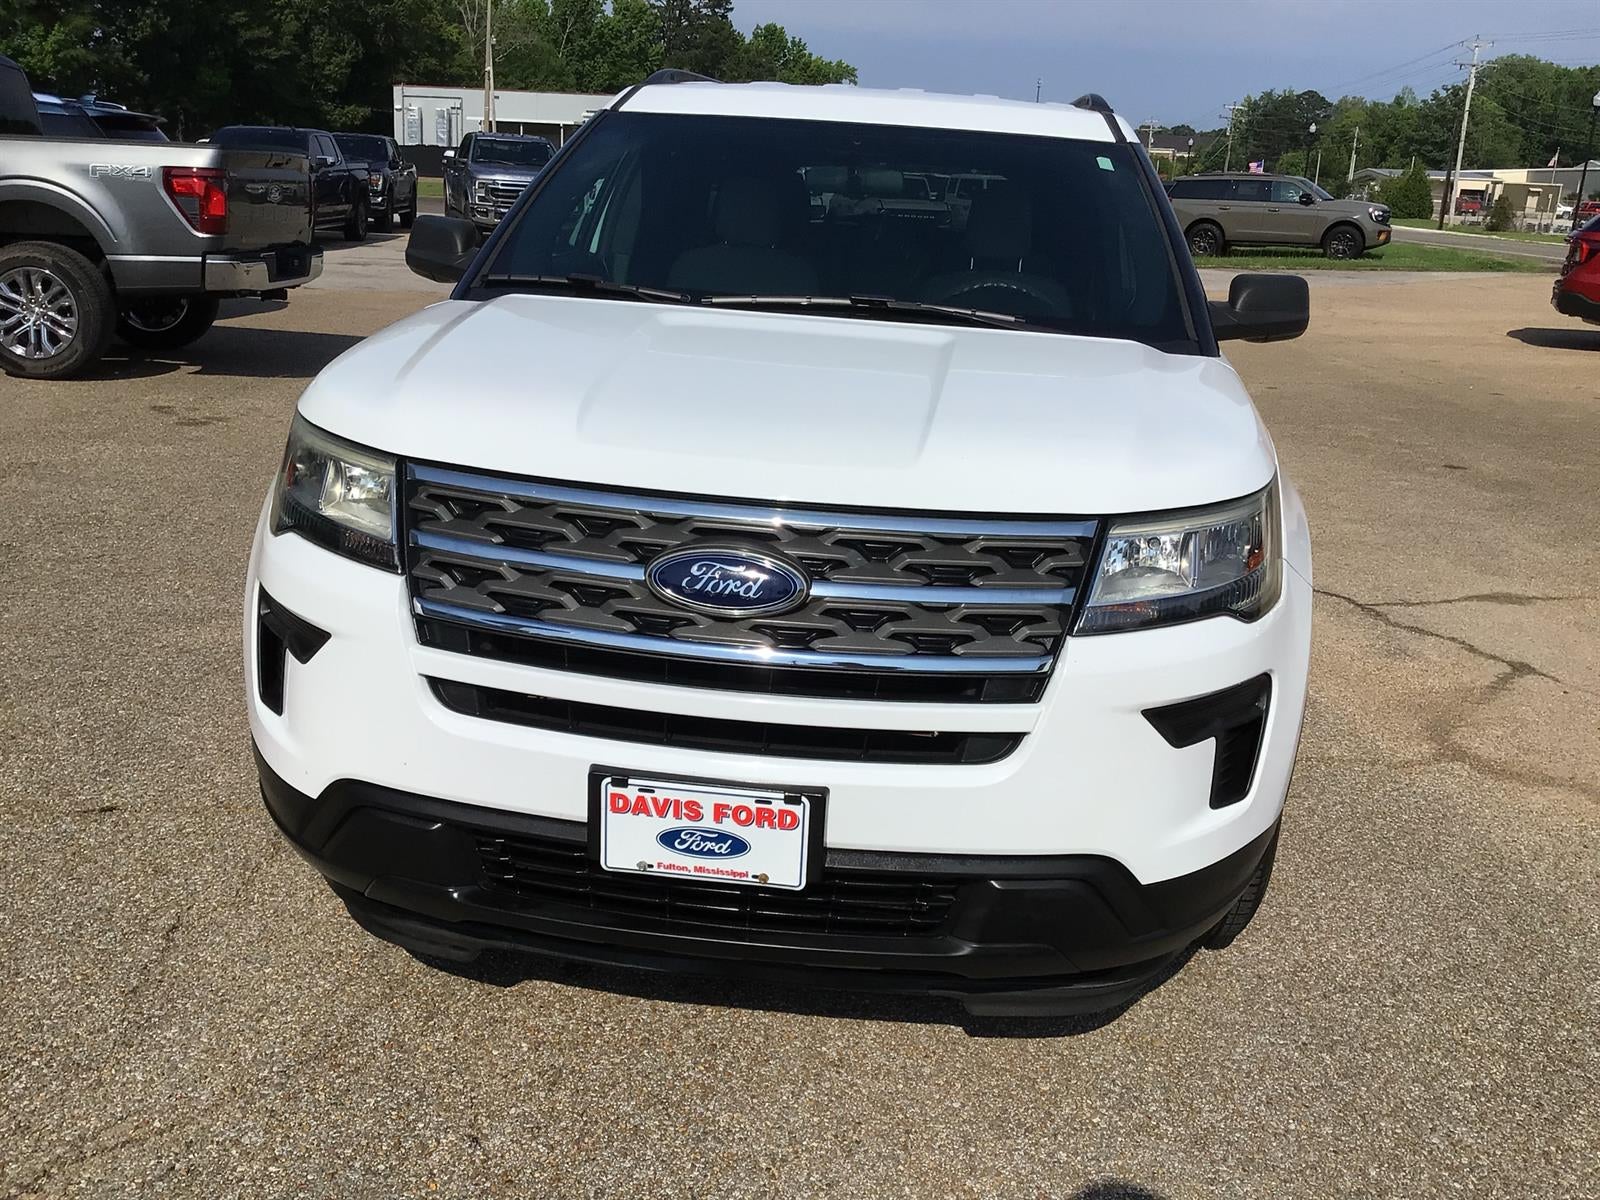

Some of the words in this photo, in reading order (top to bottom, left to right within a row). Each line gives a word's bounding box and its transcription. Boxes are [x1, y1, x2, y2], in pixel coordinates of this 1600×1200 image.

[89, 164, 152, 178] FX4
[681, 561, 768, 599] Ford
[609, 792, 704, 822] DAVIS
[713, 803, 800, 830] FORD
[674, 829, 731, 855] Ford
[656, 862, 691, 873] Fulton,
[693, 865, 749, 878] Mississippi
